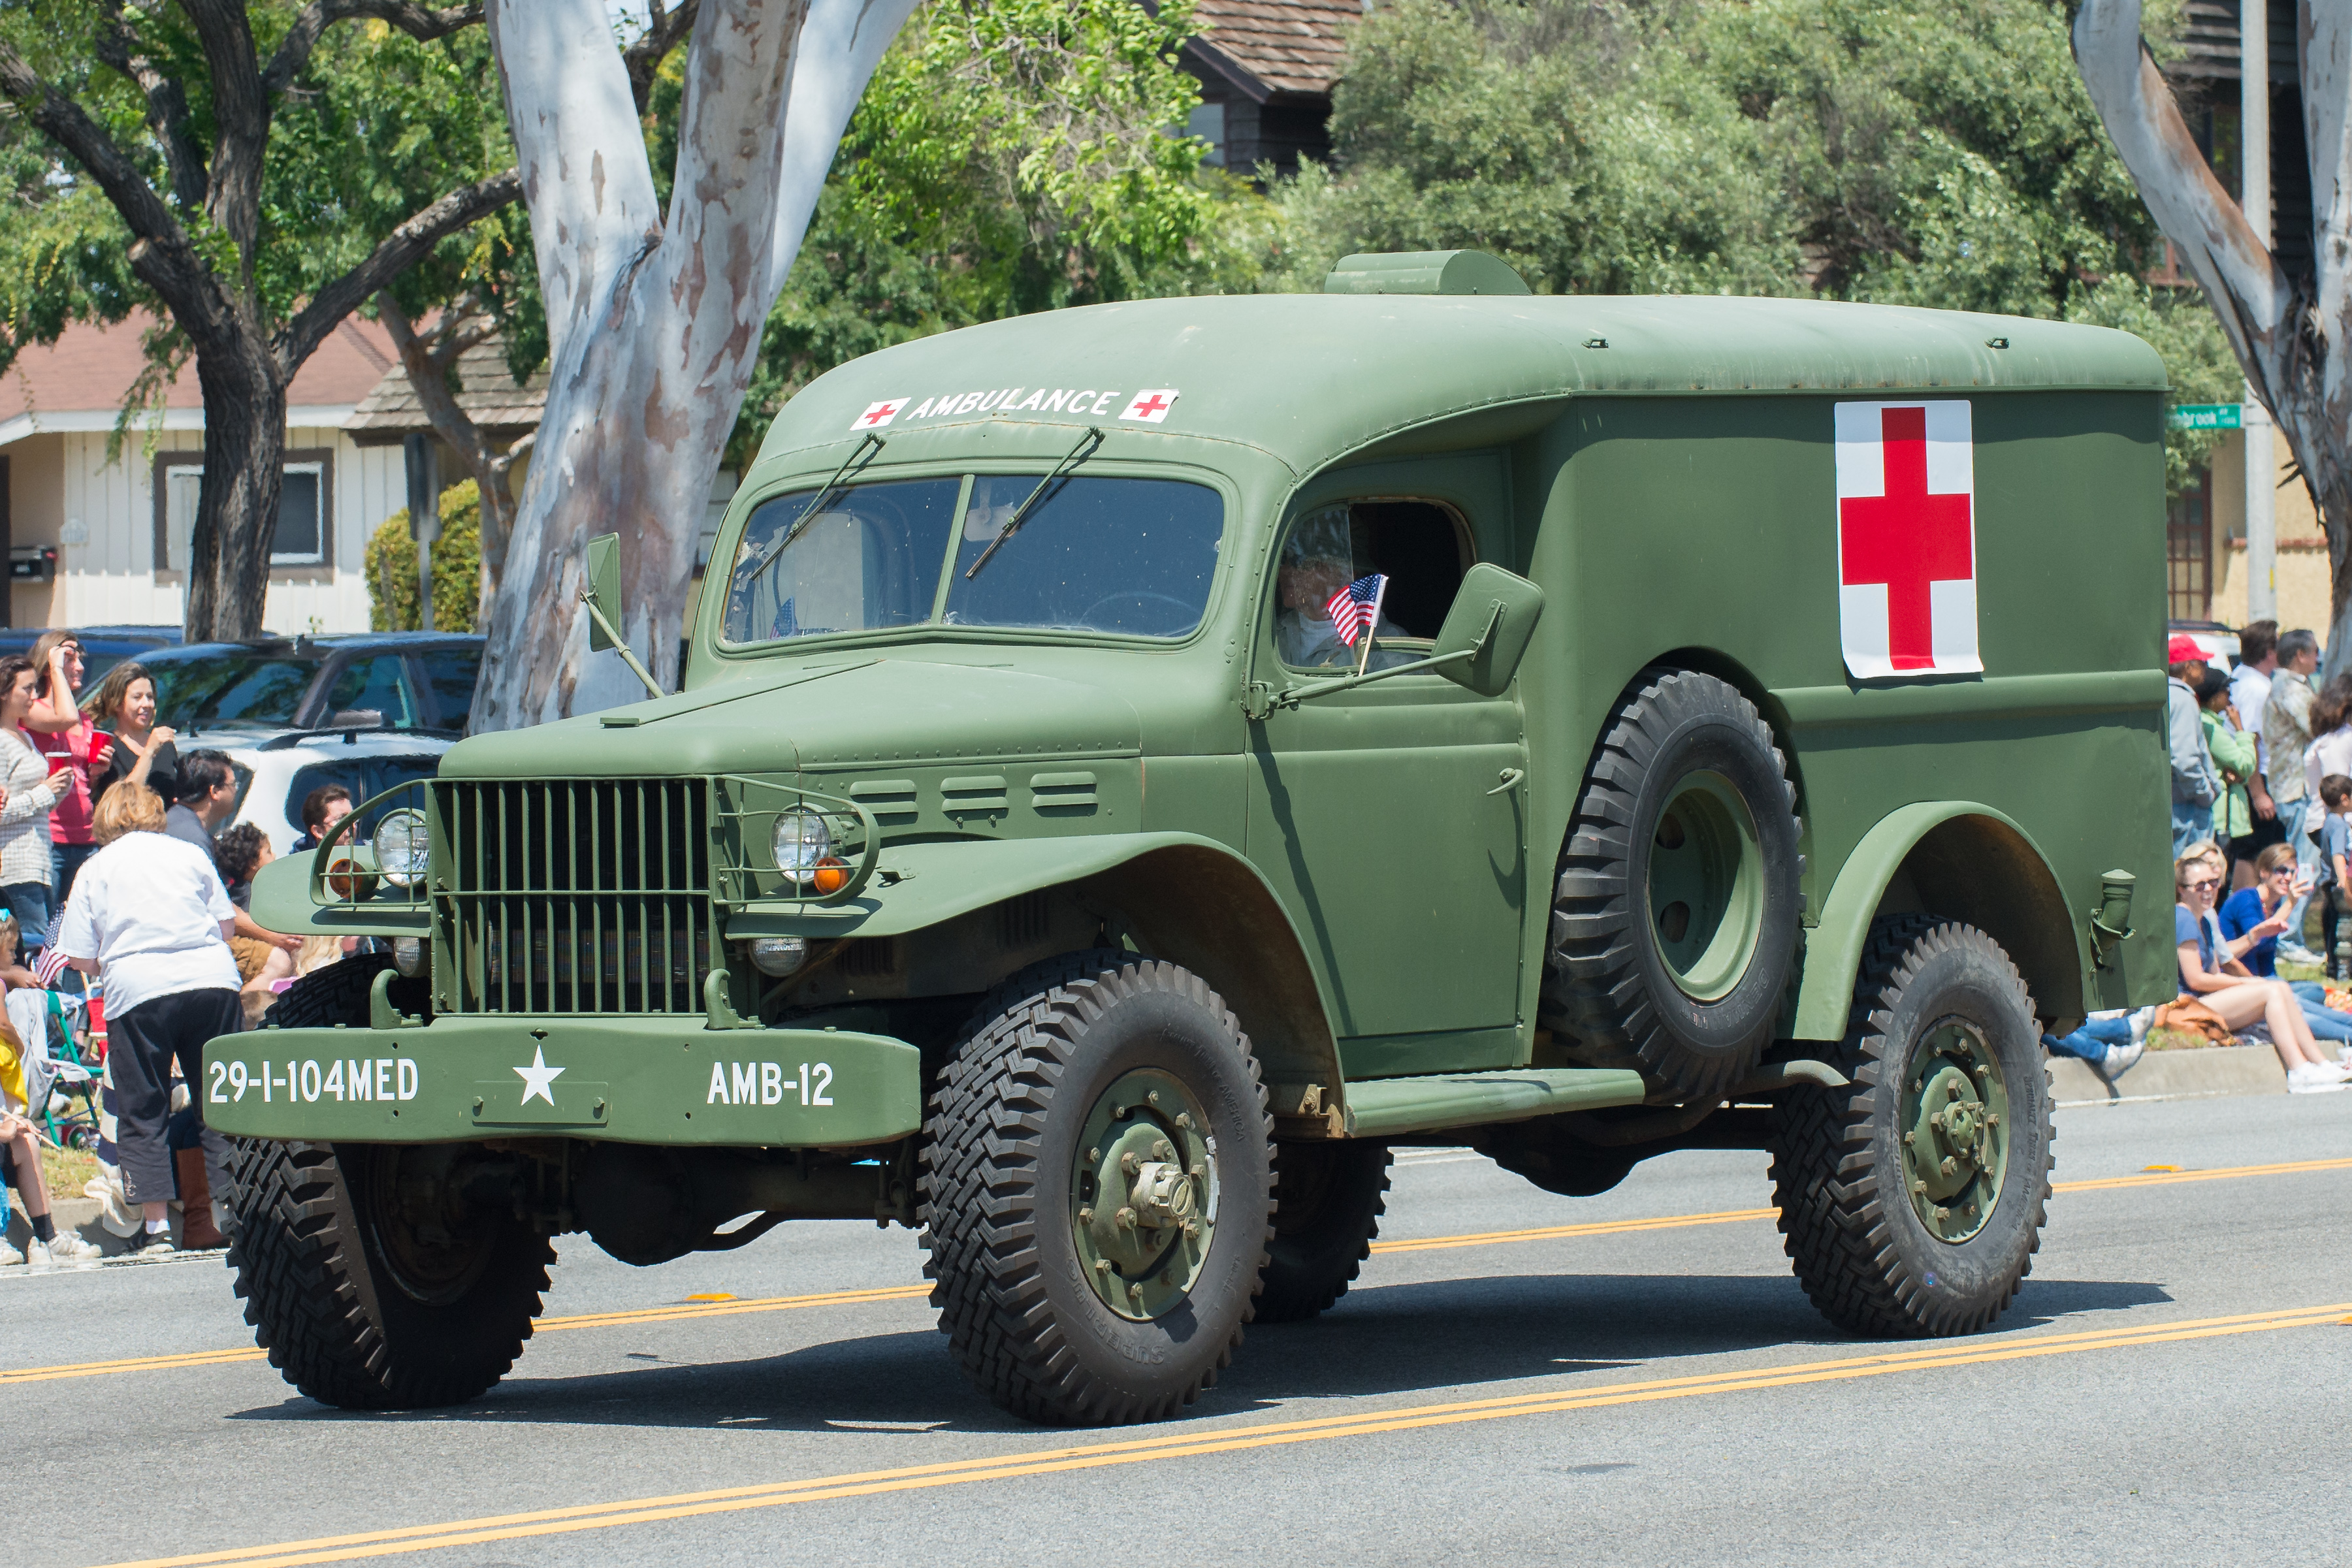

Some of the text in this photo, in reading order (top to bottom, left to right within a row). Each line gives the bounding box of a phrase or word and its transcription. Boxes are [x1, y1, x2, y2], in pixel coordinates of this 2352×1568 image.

[905, 387, 1121, 421] AMBULANCE
[1711, 967, 1771, 1031] DENMAN
[707, 1061, 834, 1106] AMB-12
[1219, 1084, 1246, 1143] AMERICA
